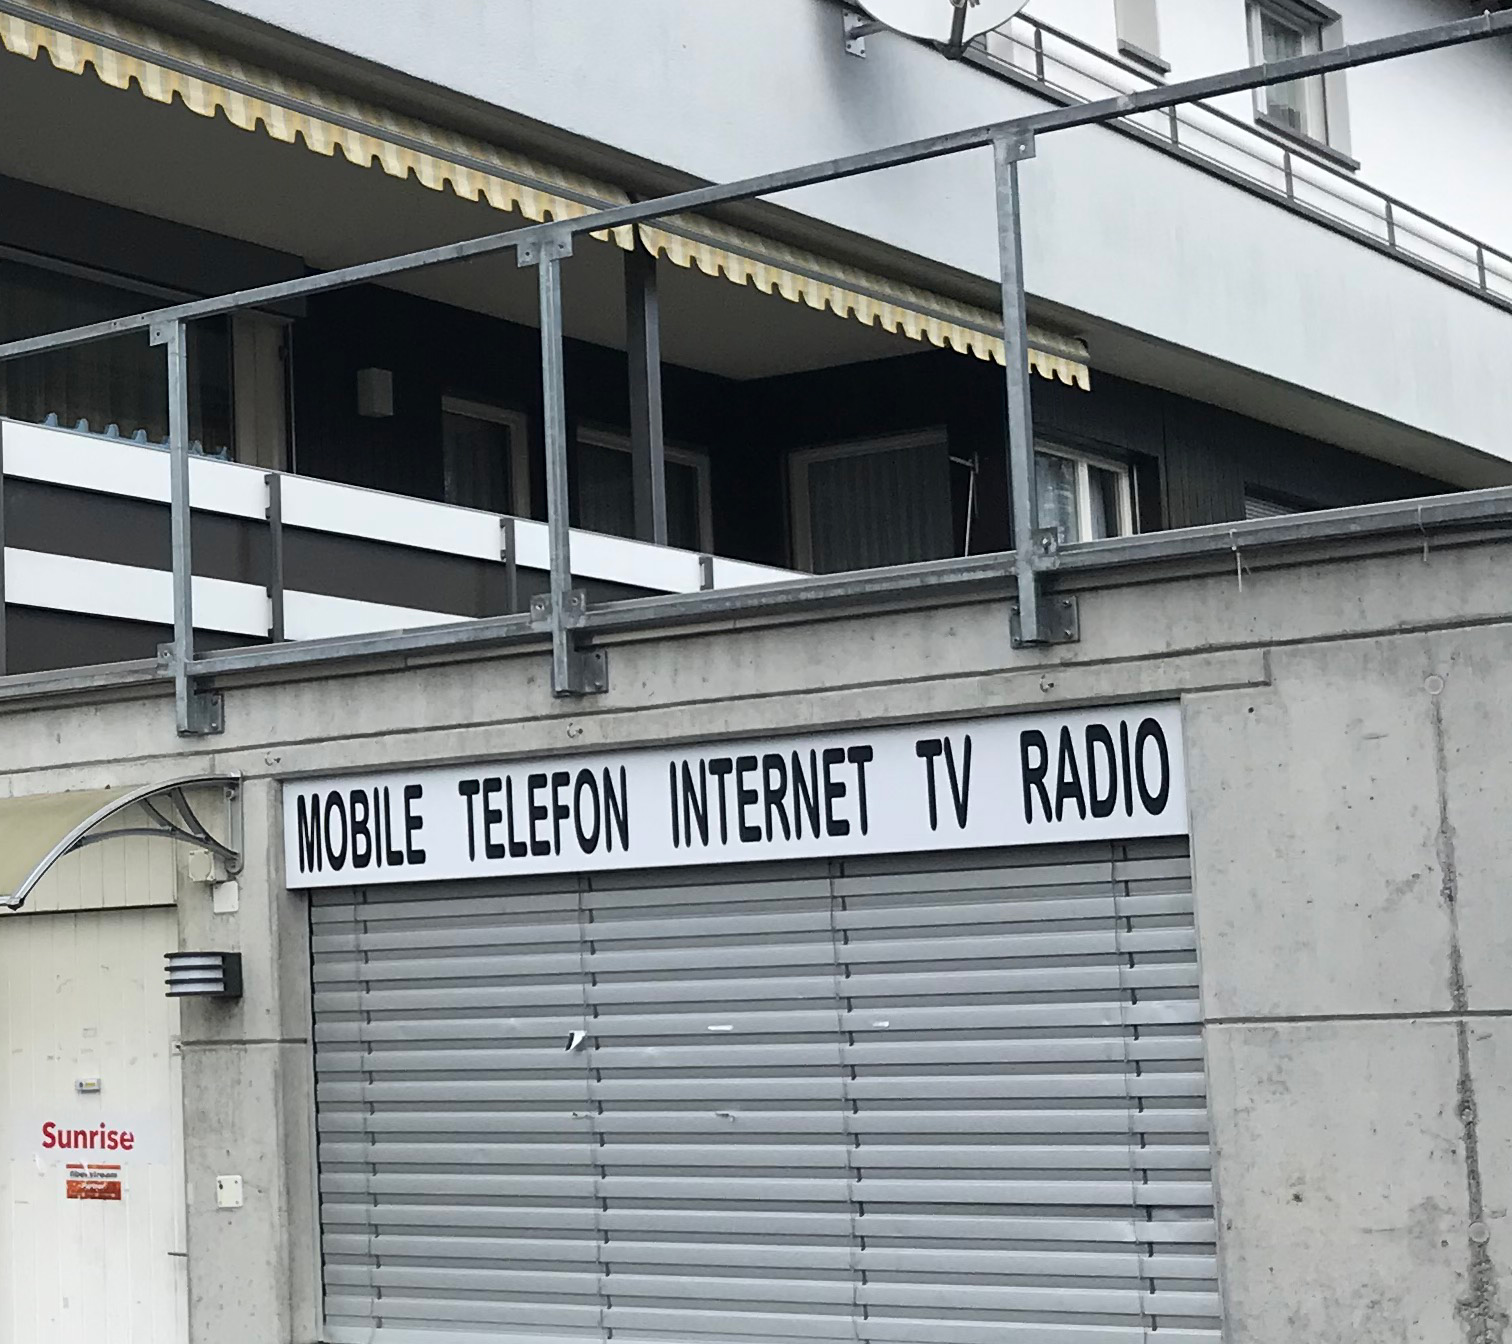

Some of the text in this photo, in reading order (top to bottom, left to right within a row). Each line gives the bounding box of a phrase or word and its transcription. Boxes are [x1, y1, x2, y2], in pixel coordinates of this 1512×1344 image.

[297, 718, 1170, 874] MOBILE TELEFON INTERNET TV RADIO
[42, 1122, 135, 1150] Sunrise
